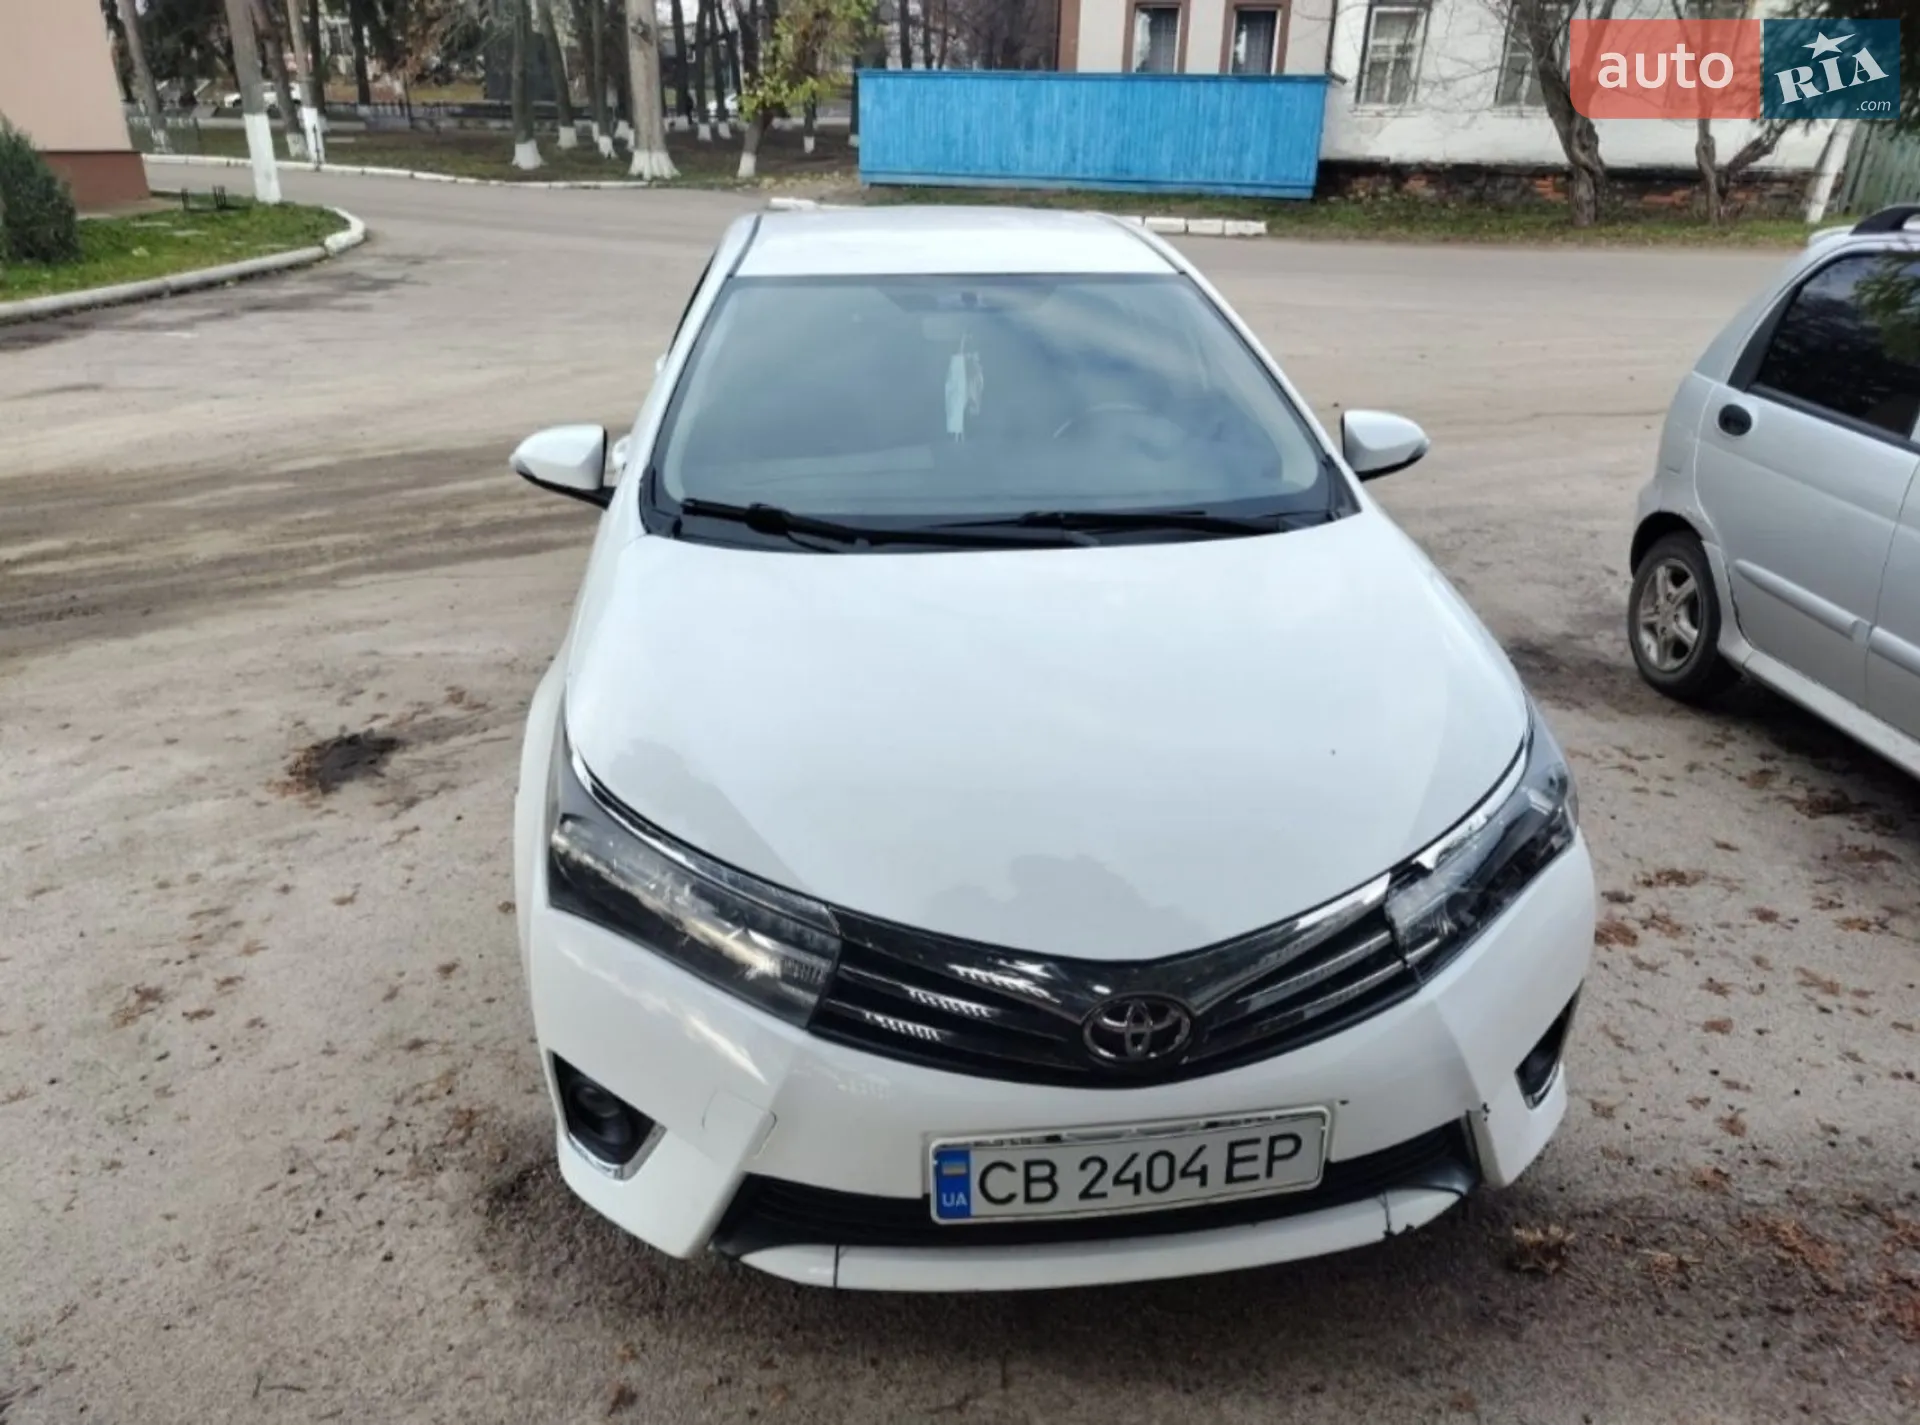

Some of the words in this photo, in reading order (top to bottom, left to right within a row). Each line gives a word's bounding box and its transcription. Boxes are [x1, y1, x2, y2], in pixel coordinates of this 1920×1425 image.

[978, 1159, 1059, 1206] CB
[1078, 1144, 1208, 1201] 2404
[1224, 1132, 1302, 1185] EP
[942, 1192, 968, 1207] UA
